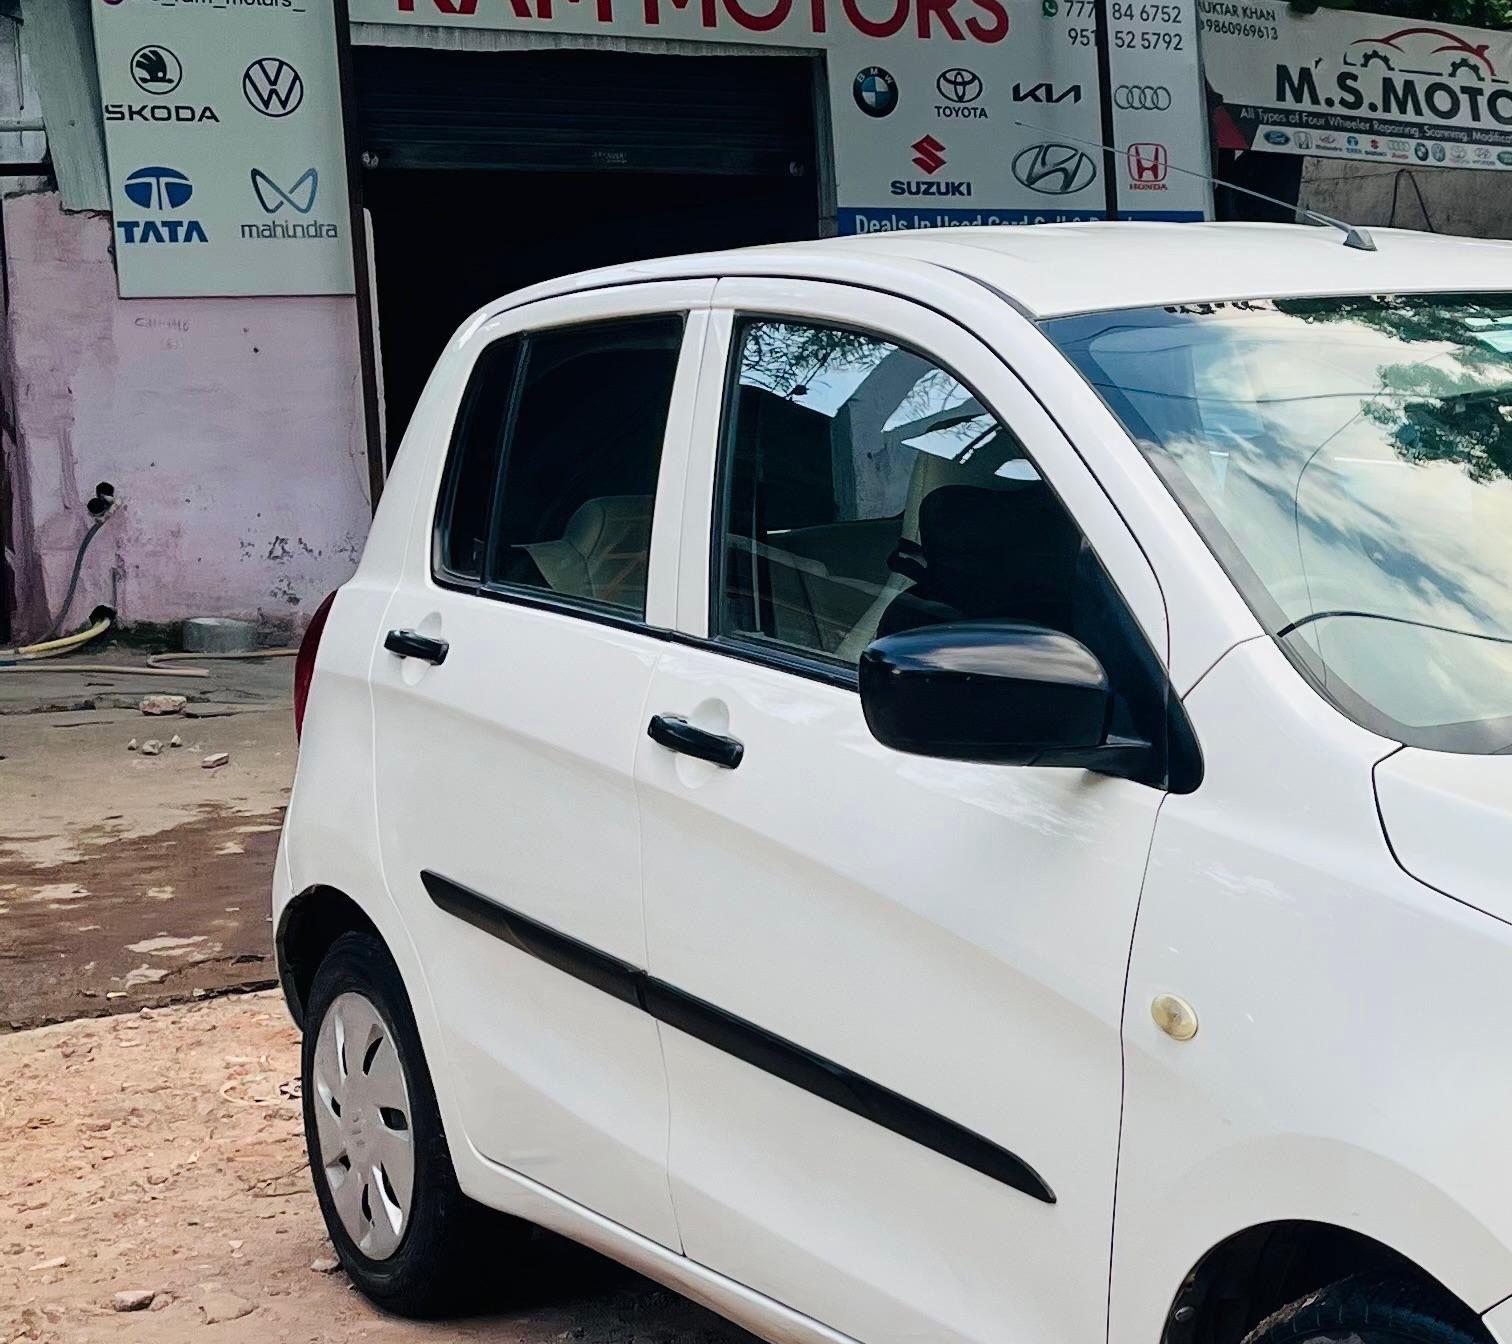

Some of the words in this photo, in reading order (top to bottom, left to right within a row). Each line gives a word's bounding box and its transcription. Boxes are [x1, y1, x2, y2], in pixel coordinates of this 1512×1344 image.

[1063, 0, 1096, 18] 777
[1111, 2, 1135, 21] 84
[1139, 4, 1183, 24] 6752
[1241, 6, 1276, 22] KHAN
[1068, 28, 1098, 48] 951
[1114, 31, 1136, 50] 52
[1140, 32, 1184, 52] 5792
[104, 104, 220, 123] SKODA
[934, 105, 988, 119] TOYOTA
[1240, 108, 1254, 119] All
[1289, 112, 1299, 124] of
[890, 180, 972, 197] SUZUKI
[1129, 182, 1168, 191] HONDA
[117, 220, 209, 244] TATA
[240, 219, 338, 239] mahindra
[855, 214, 908, 234] Deals
